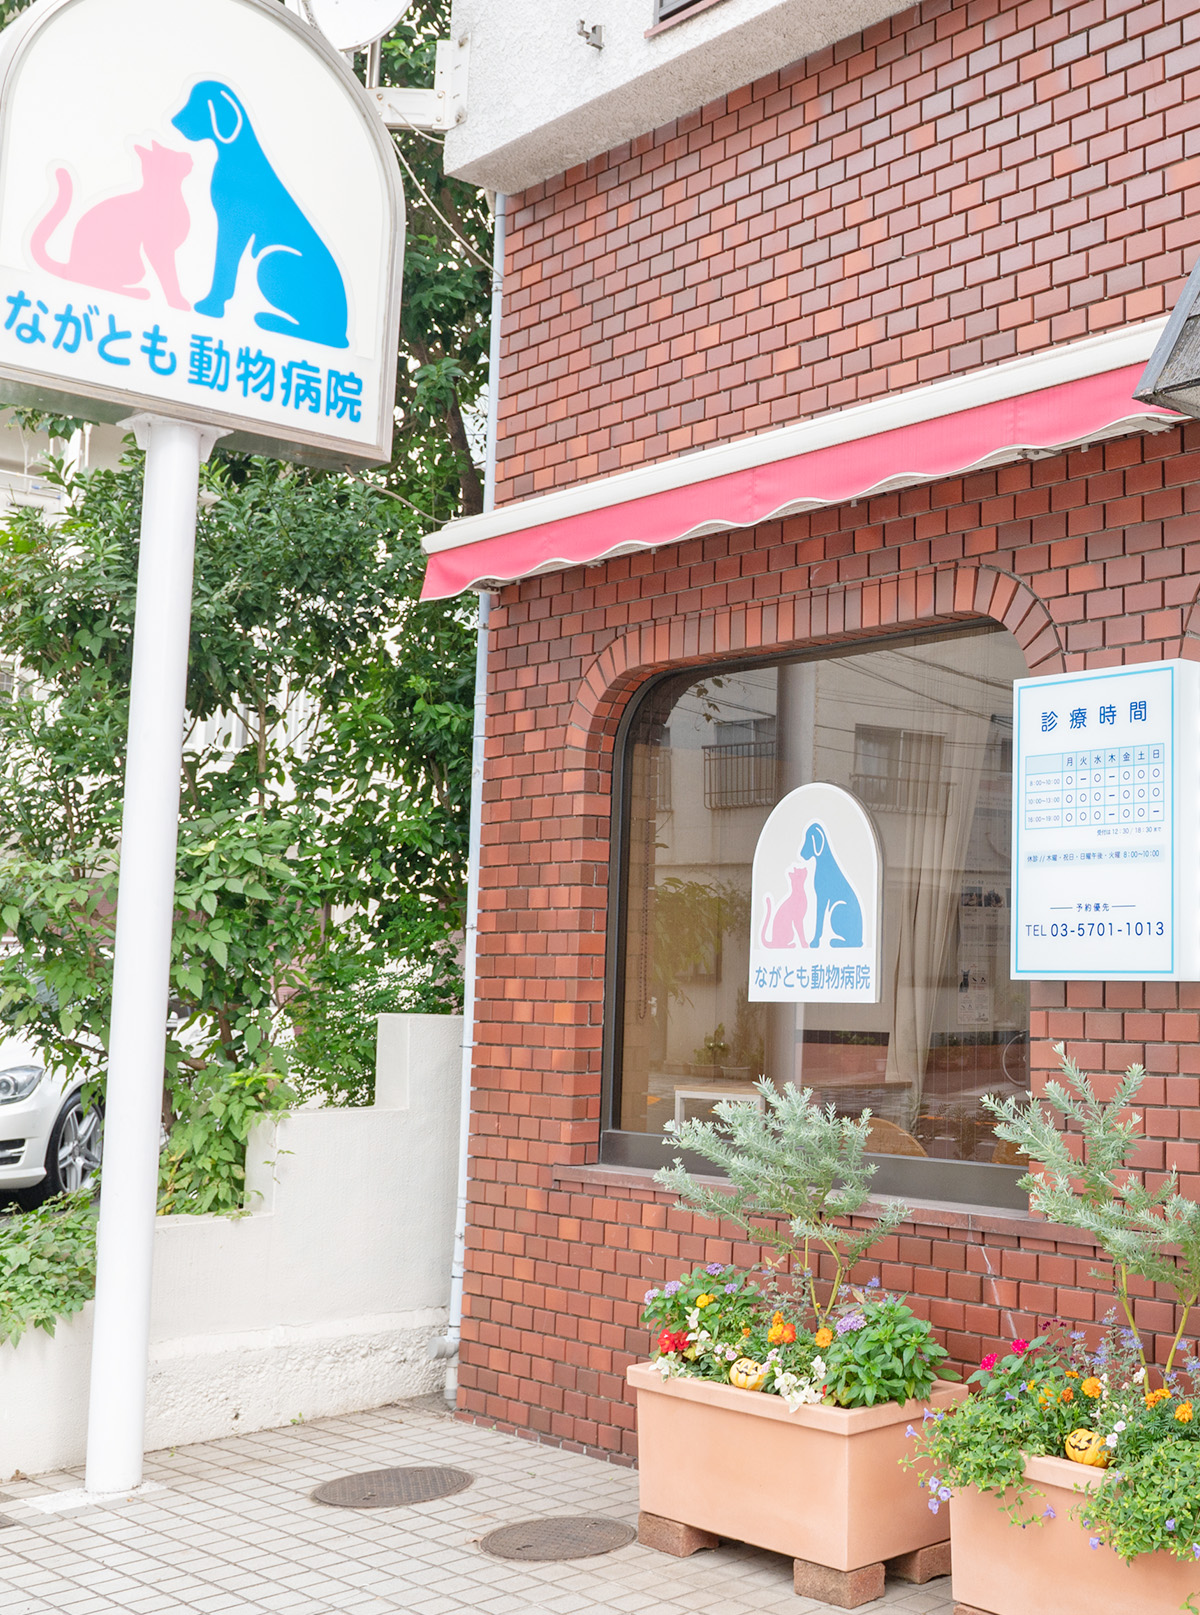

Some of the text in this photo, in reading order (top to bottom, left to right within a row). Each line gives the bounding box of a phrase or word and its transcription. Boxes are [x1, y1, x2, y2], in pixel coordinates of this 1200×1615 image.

[4, 290, 364, 423] ながとも動物病院
[1041, 700, 1147, 732] 診療時間
[1066, 749, 1160, 766] 月 火 水 木 金 土 日
[1076, 903, 1109, 912] 予約優先
[1025, 921, 1164, 937] TEL 03-5701-1013
[754, 964, 871, 990] ながとも動物病院
